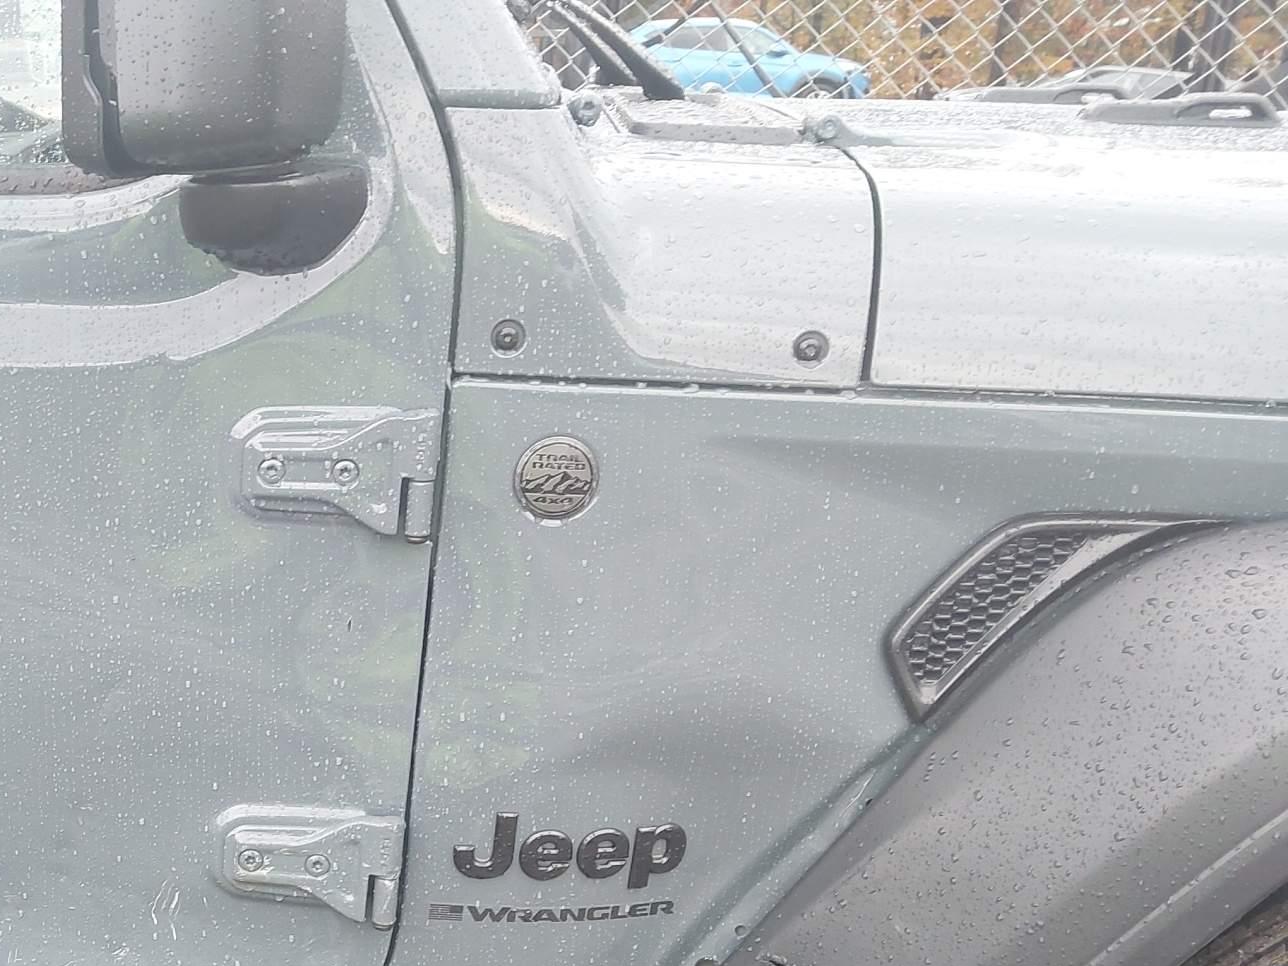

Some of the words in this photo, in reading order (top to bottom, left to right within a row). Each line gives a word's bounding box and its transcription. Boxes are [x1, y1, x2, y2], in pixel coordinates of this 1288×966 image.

[532, 461, 586, 471] RATED
[535, 453, 582, 463] TRAIL
[452, 811, 688, 890] Jeep
[466, 900, 675, 923] WRANGLER
